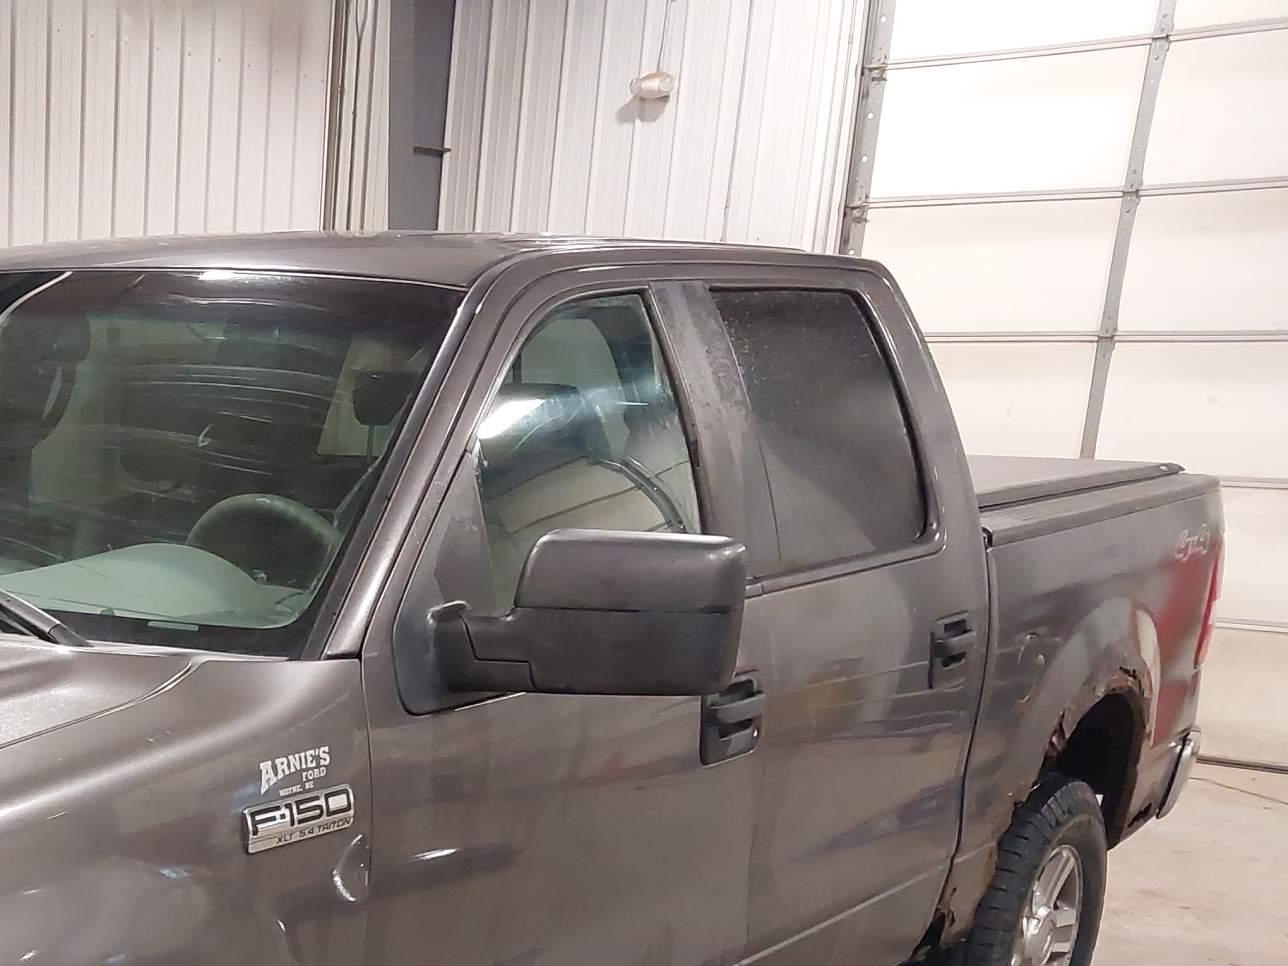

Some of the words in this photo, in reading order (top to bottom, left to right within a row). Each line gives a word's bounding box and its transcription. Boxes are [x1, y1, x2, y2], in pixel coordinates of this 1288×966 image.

[259, 746, 330, 795] ARNIE'S
[302, 767, 326, 781] FORD
[250, 788, 351, 836] F-150
